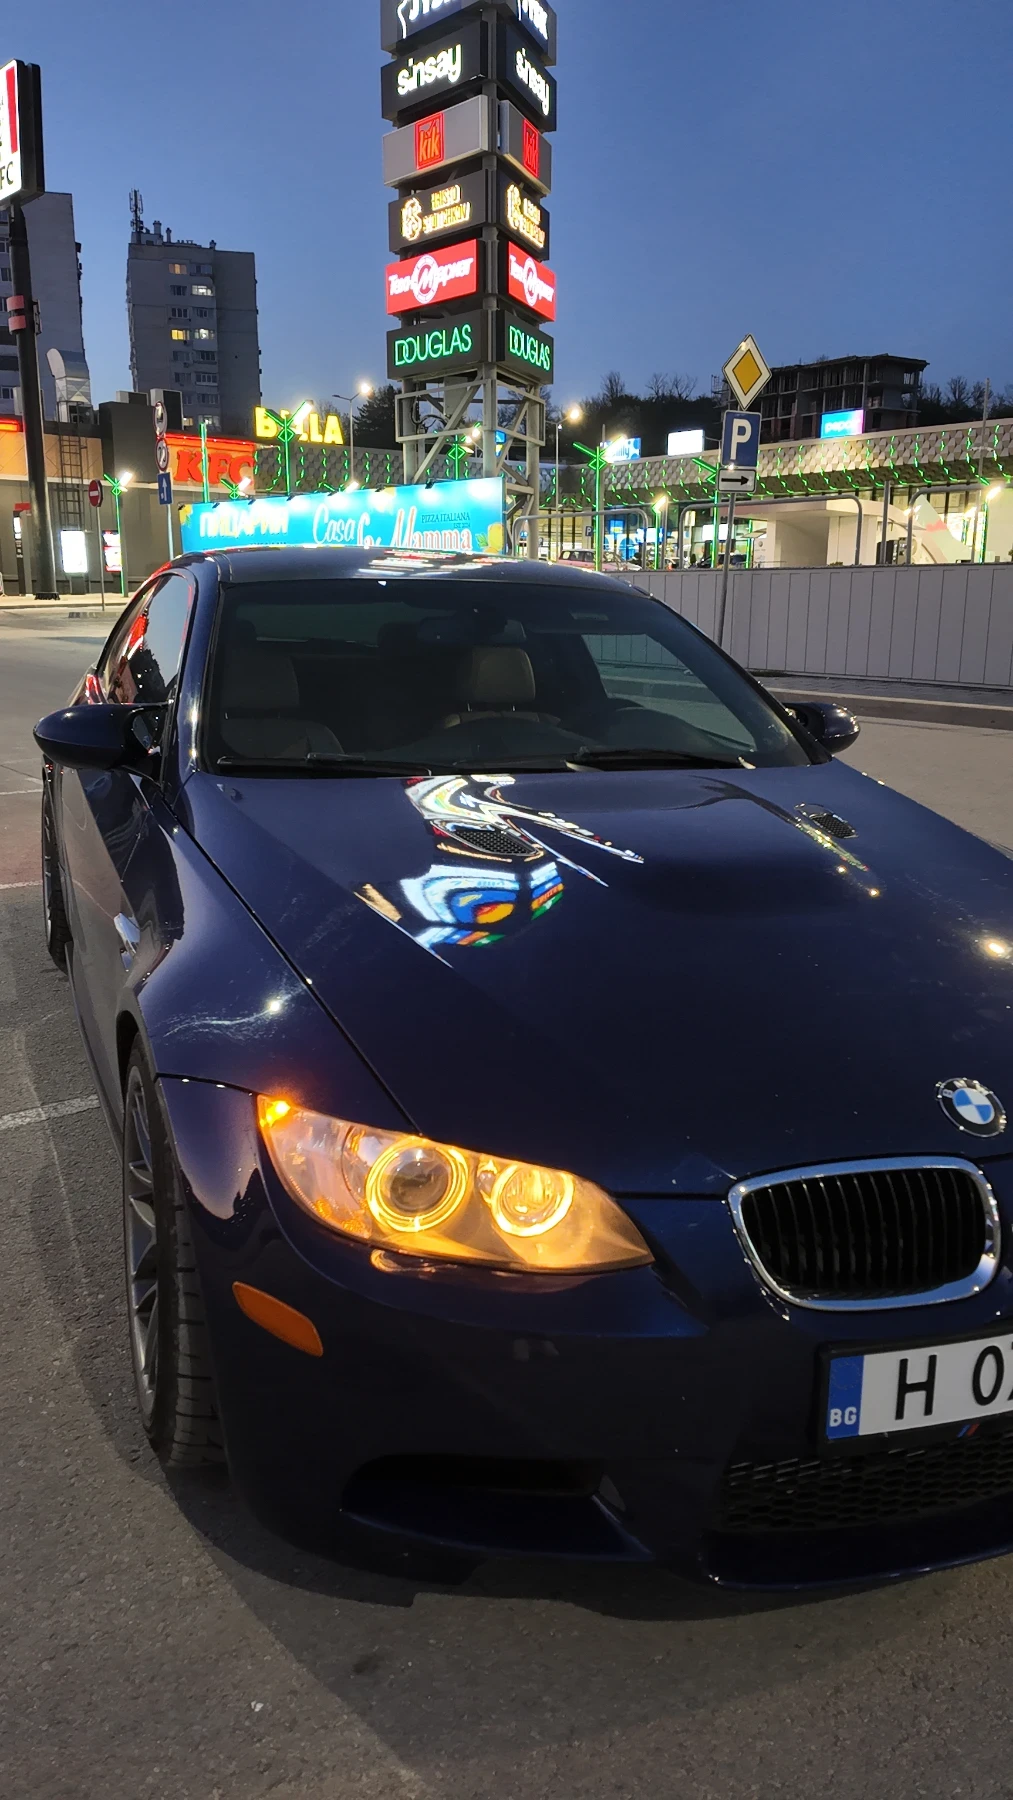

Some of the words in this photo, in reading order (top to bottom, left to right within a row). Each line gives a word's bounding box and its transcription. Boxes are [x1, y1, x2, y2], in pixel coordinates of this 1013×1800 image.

[397, 44, 462, 95] sinsay
[516, 48, 549, 116] sinsay
[0, 161, 13, 190] FC
[394, 323, 473, 366] DOUGLAS
[509, 325, 551, 371] DOUGLAS
[254, 406, 344, 445] BLLA
[730, 418, 752, 460] P
[174, 449, 255, 485] KFC
[313, 503, 356, 544] Casa
[390, 506, 473, 549] Mamma
[421, 513, 440, 523] PIZZA
[440, 511, 470, 522] ITALIANA
[895, 1354, 938, 1421] H
[829, 1406, 858, 1428] BG
